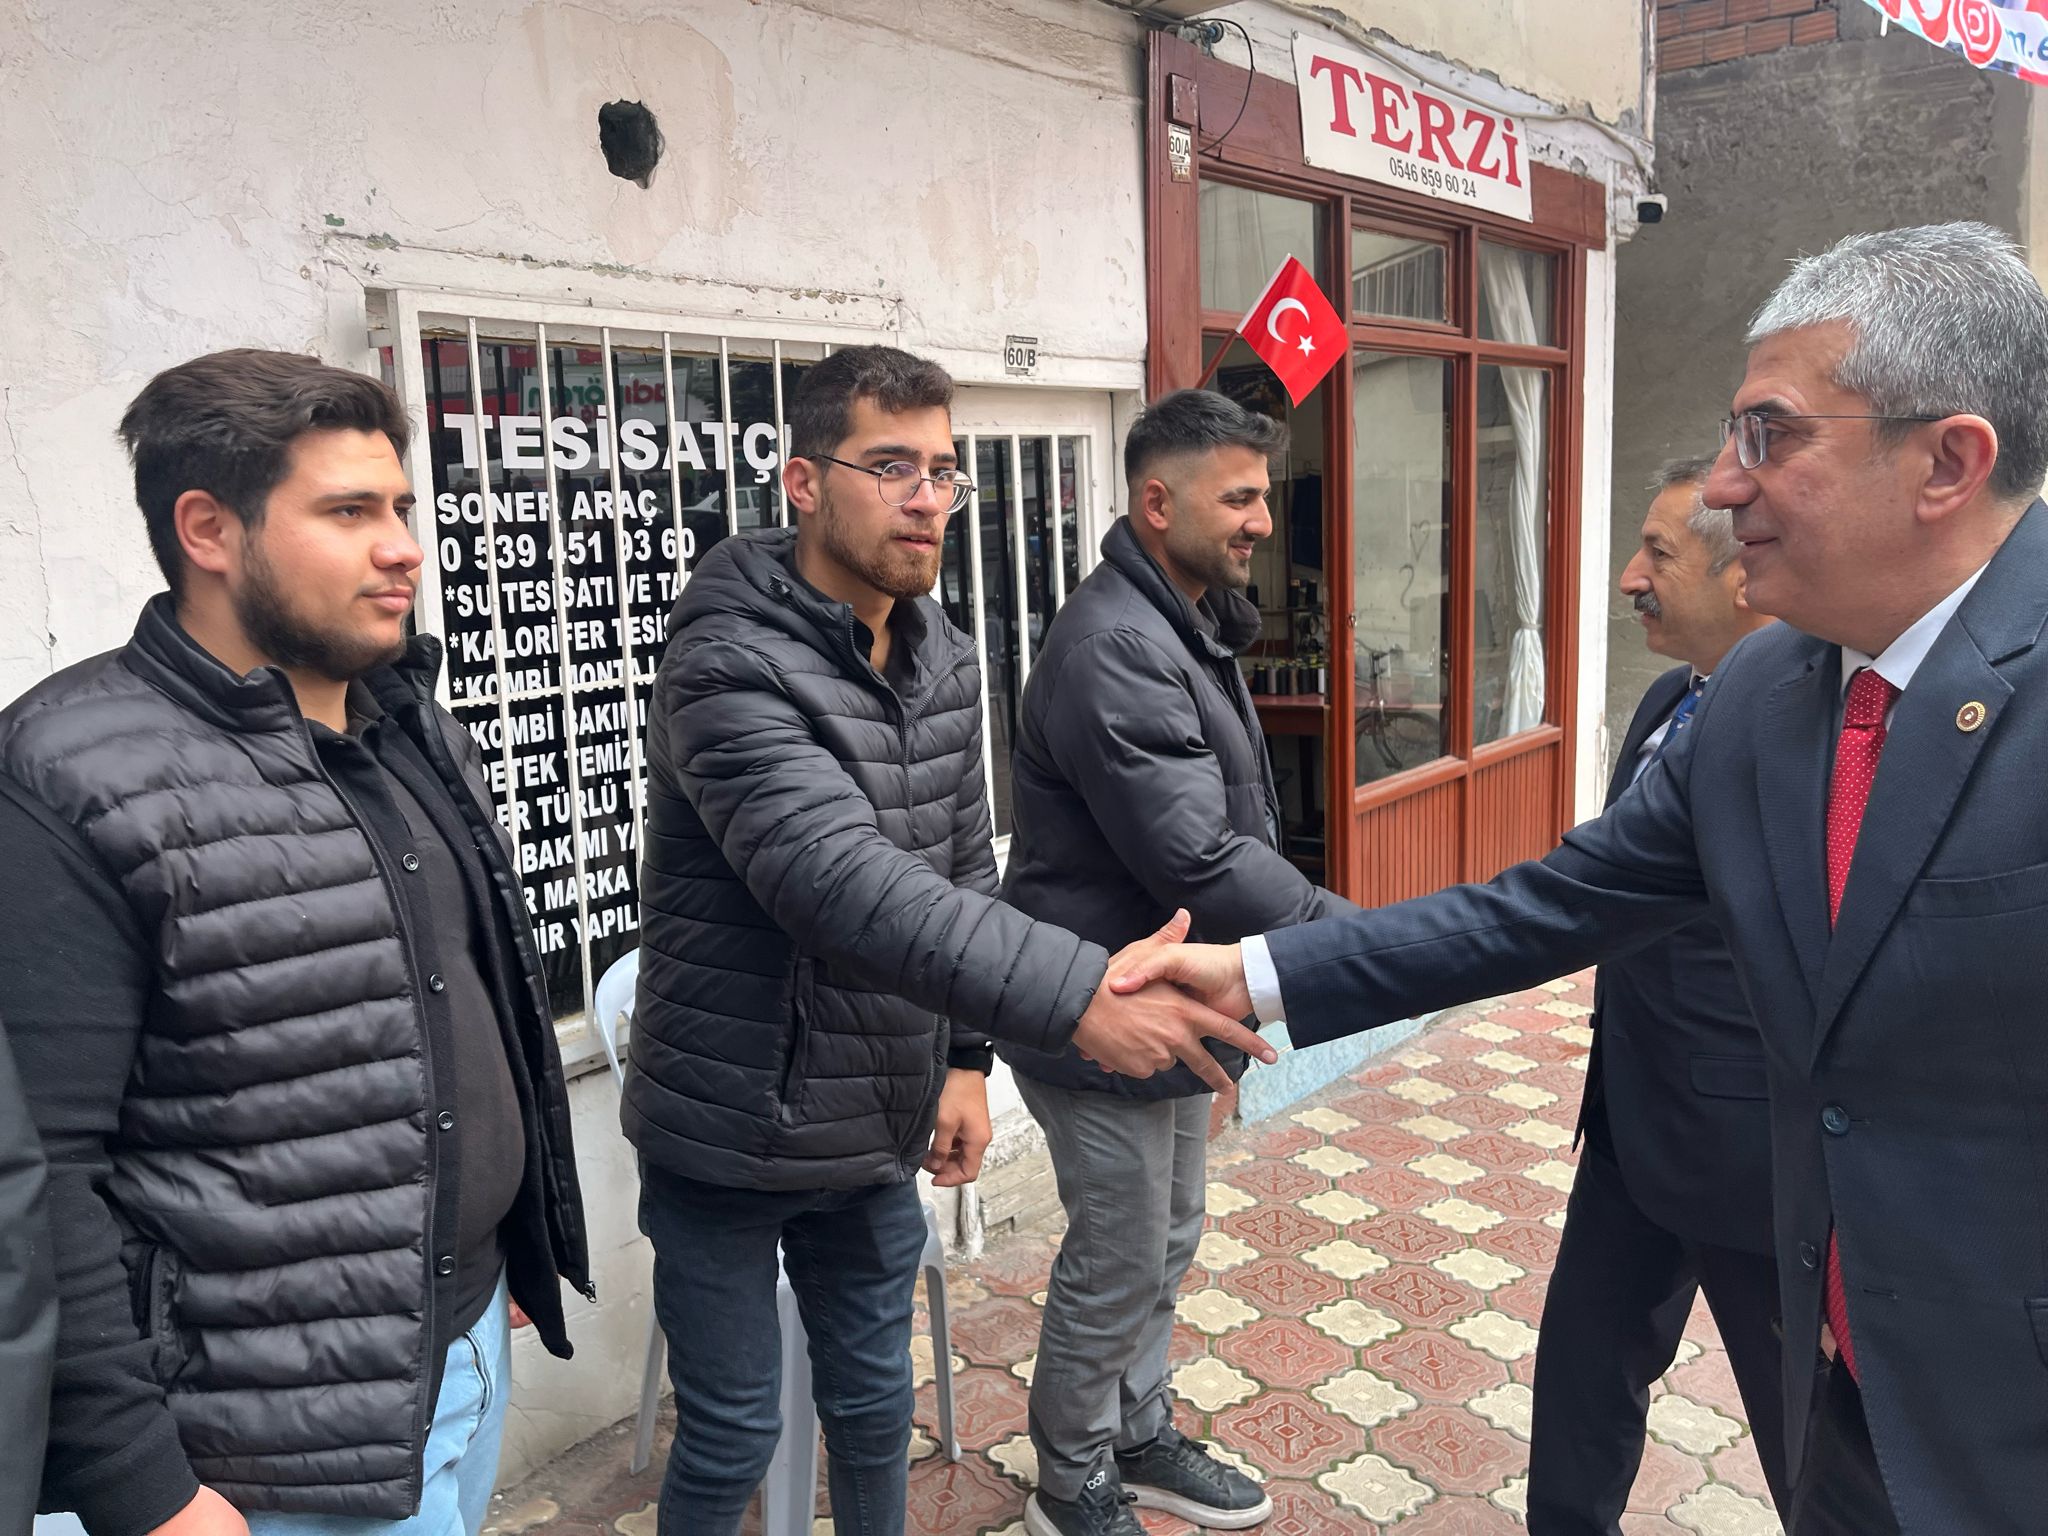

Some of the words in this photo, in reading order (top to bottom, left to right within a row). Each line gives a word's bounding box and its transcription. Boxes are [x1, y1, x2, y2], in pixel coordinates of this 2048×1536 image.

[1169, 136, 1191, 157] 60/A
[1389, 157, 1418, 182] 0546
[1421, 167, 1442, 189] 859
[1445, 174, 1459, 193] 60
[1462, 178, 1476, 198] 24
[1007, 347, 1036, 367] 60/B
[437, 491, 561, 525] SONER
[571, 489, 657, 526] ARAÇ
[440, 537, 461, 572] 0
[474, 534, 537, 571] 539
[547, 531, 602, 565] 451
[622, 529, 652, 562] 93
[661, 528, 695, 560] 60
[502, 572, 614, 614] TESİSATI
[461, 704, 555, 751] KOMBİ
[562, 699, 646, 738] BAKIMI
[537, 777, 618, 826] TÜRLÜ
[521, 827, 608, 874] BAKMI
[543, 865, 631, 911] MARKA
[532, 919, 566, 954] İR
